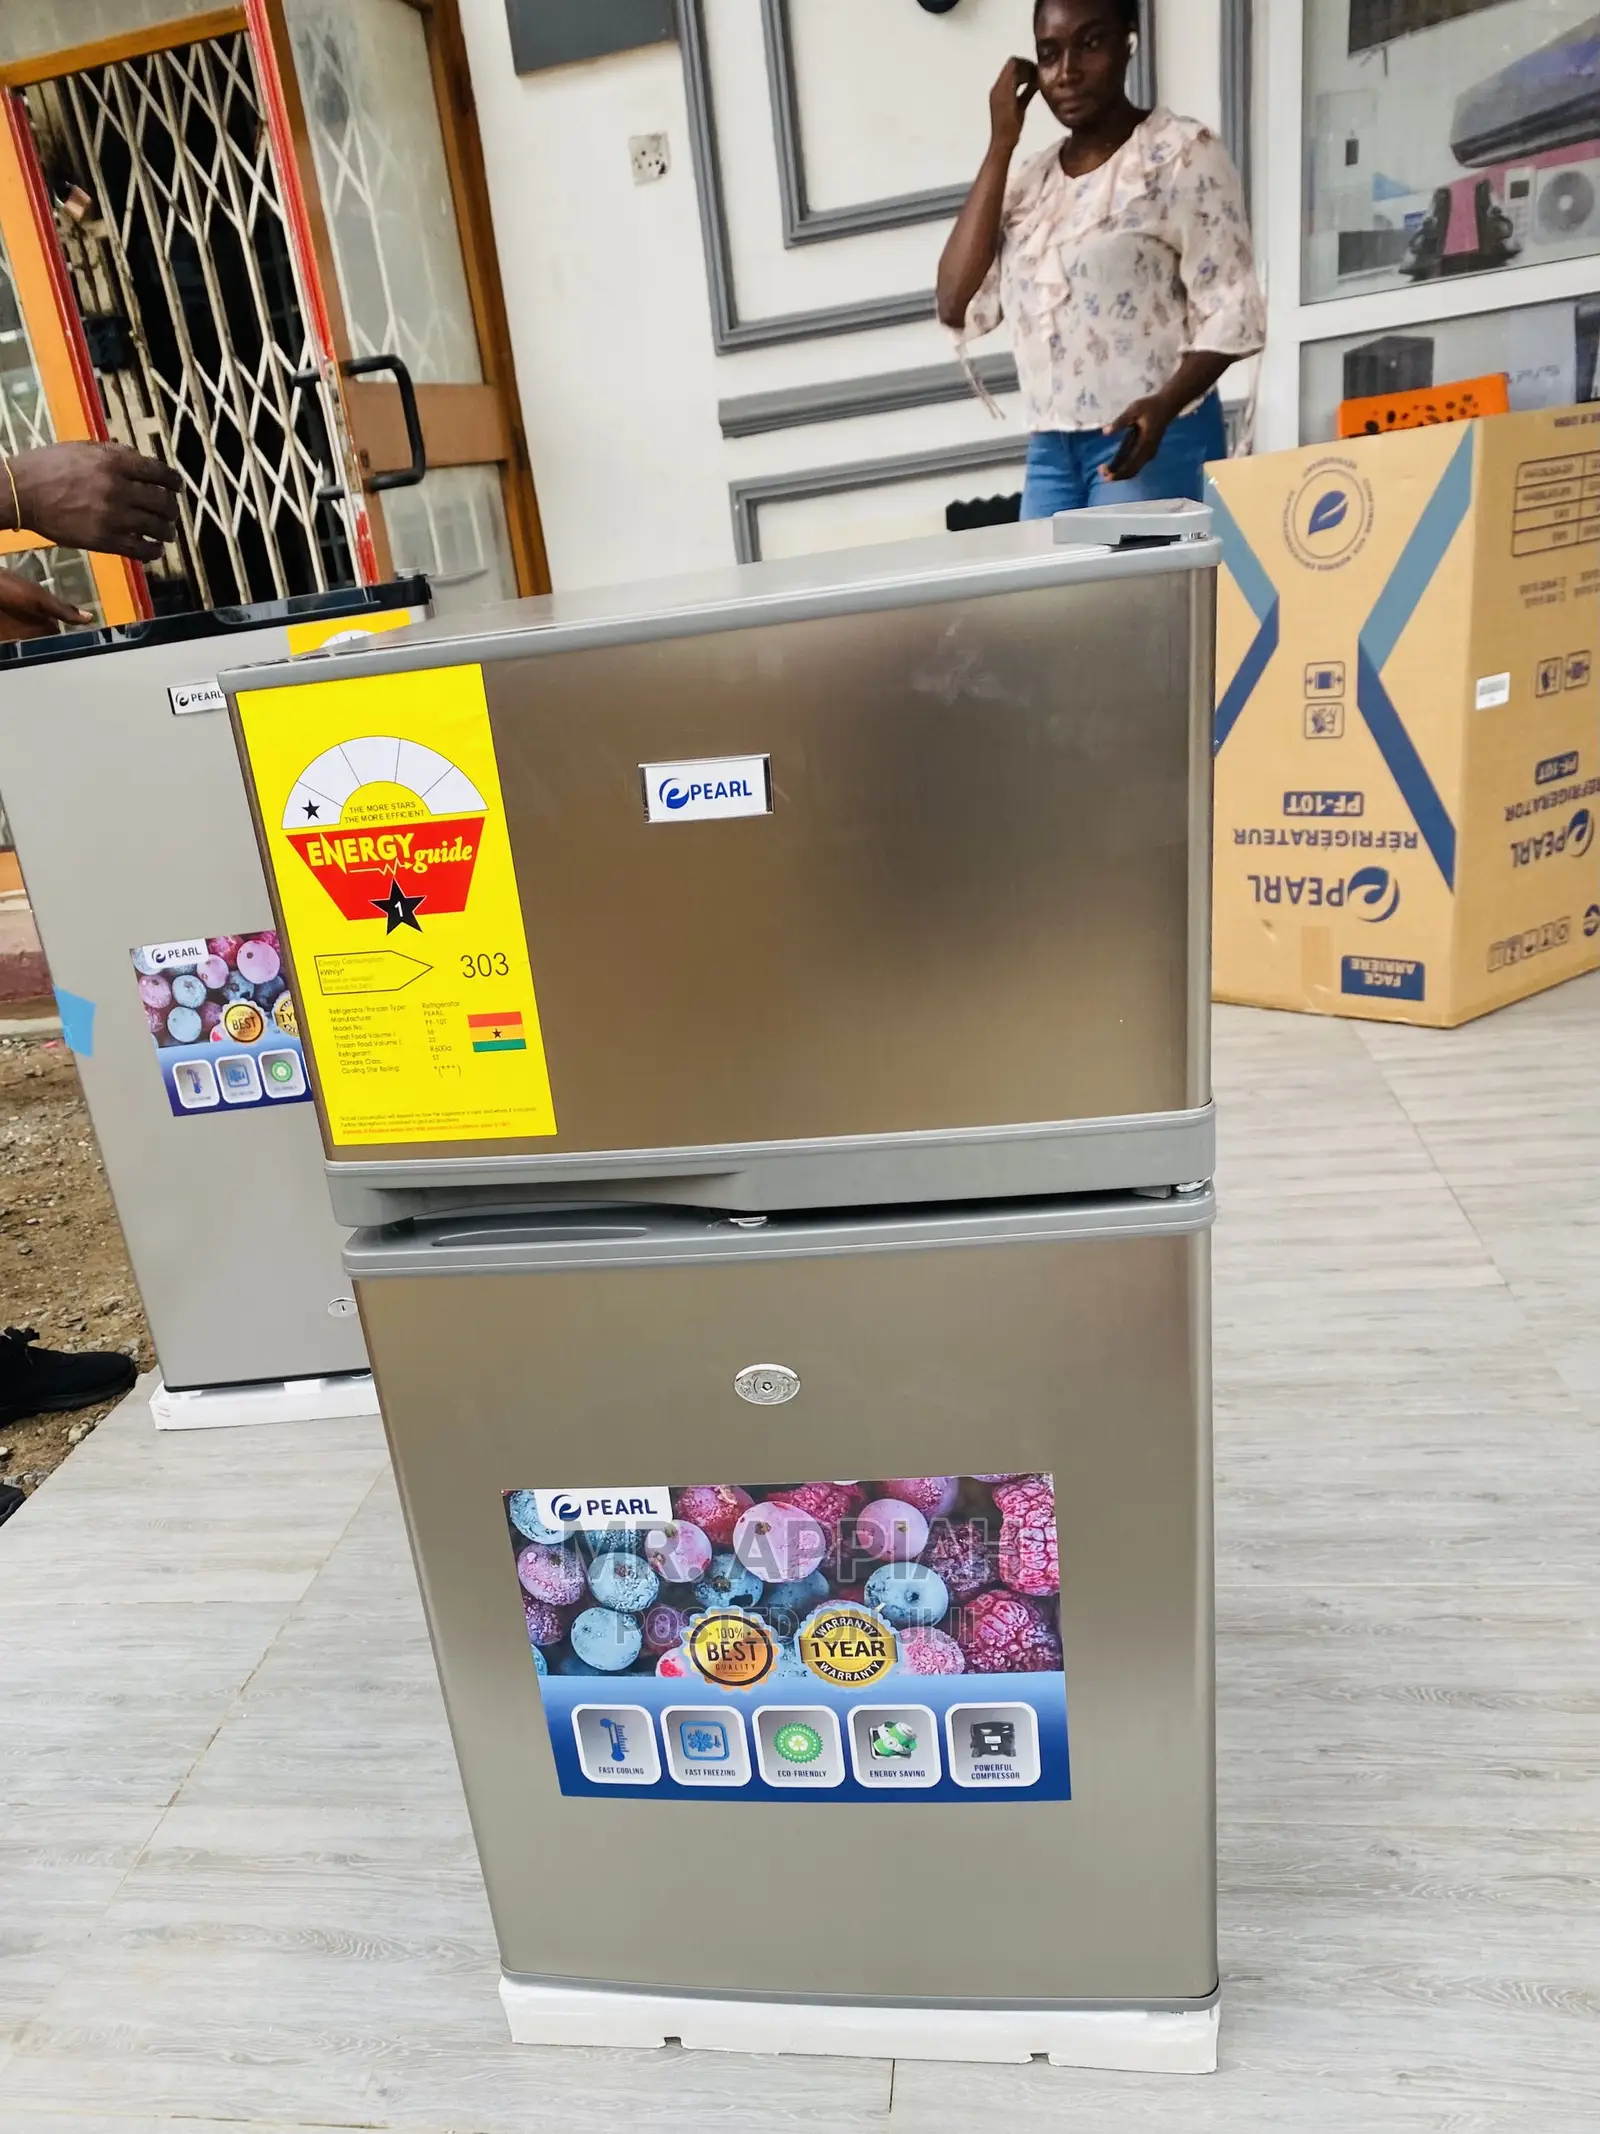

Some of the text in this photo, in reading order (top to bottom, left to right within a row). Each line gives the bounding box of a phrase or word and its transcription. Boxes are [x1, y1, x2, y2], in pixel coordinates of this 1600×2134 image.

[190, 690, 224, 702] PEARL
[690, 780, 753, 801] PEARL
[349, 801, 417, 814] THE MORE STARS
[1286, 794, 1362, 814] PF-10T
[344, 809, 425, 824] THE MORE EFFICIENT
[1232, 828, 1419, 853] RÉFRIGÉRATEUR
[1510, 826, 1570, 868] PEARL
[306, 832, 473, 875] ENERGY guide
[1247, 875, 1345, 907] PEARL
[394, 900, 404, 918] 1
[167, 946, 202, 959] PEARL
[460, 952, 509, 979] 303
[1364, 972, 1402, 988] FACE
[231, 1016, 257, 1031] BEST
[587, 1498, 658, 1516] PEARL
[715, 1627, 745, 1639] 100%
[815, 1617, 877, 1638] WARRANTY
[705, 1640, 757, 1661] BEST
[810, 1640, 887, 1658] 1 YEAR
[715, 1663, 756, 1671] QUALITY
[819, 1661, 881, 1681] WARRANTY
[598, 1766, 645, 1775] FAST COOLING
[685, 1768, 736, 1777] FAST FREEZING
[869, 1769, 926, 1778] ENERGY SAVING
[971, 1771, 1020, 1780] COMPRESSOR
[974, 1764, 1013, 1772] POWERFUL
